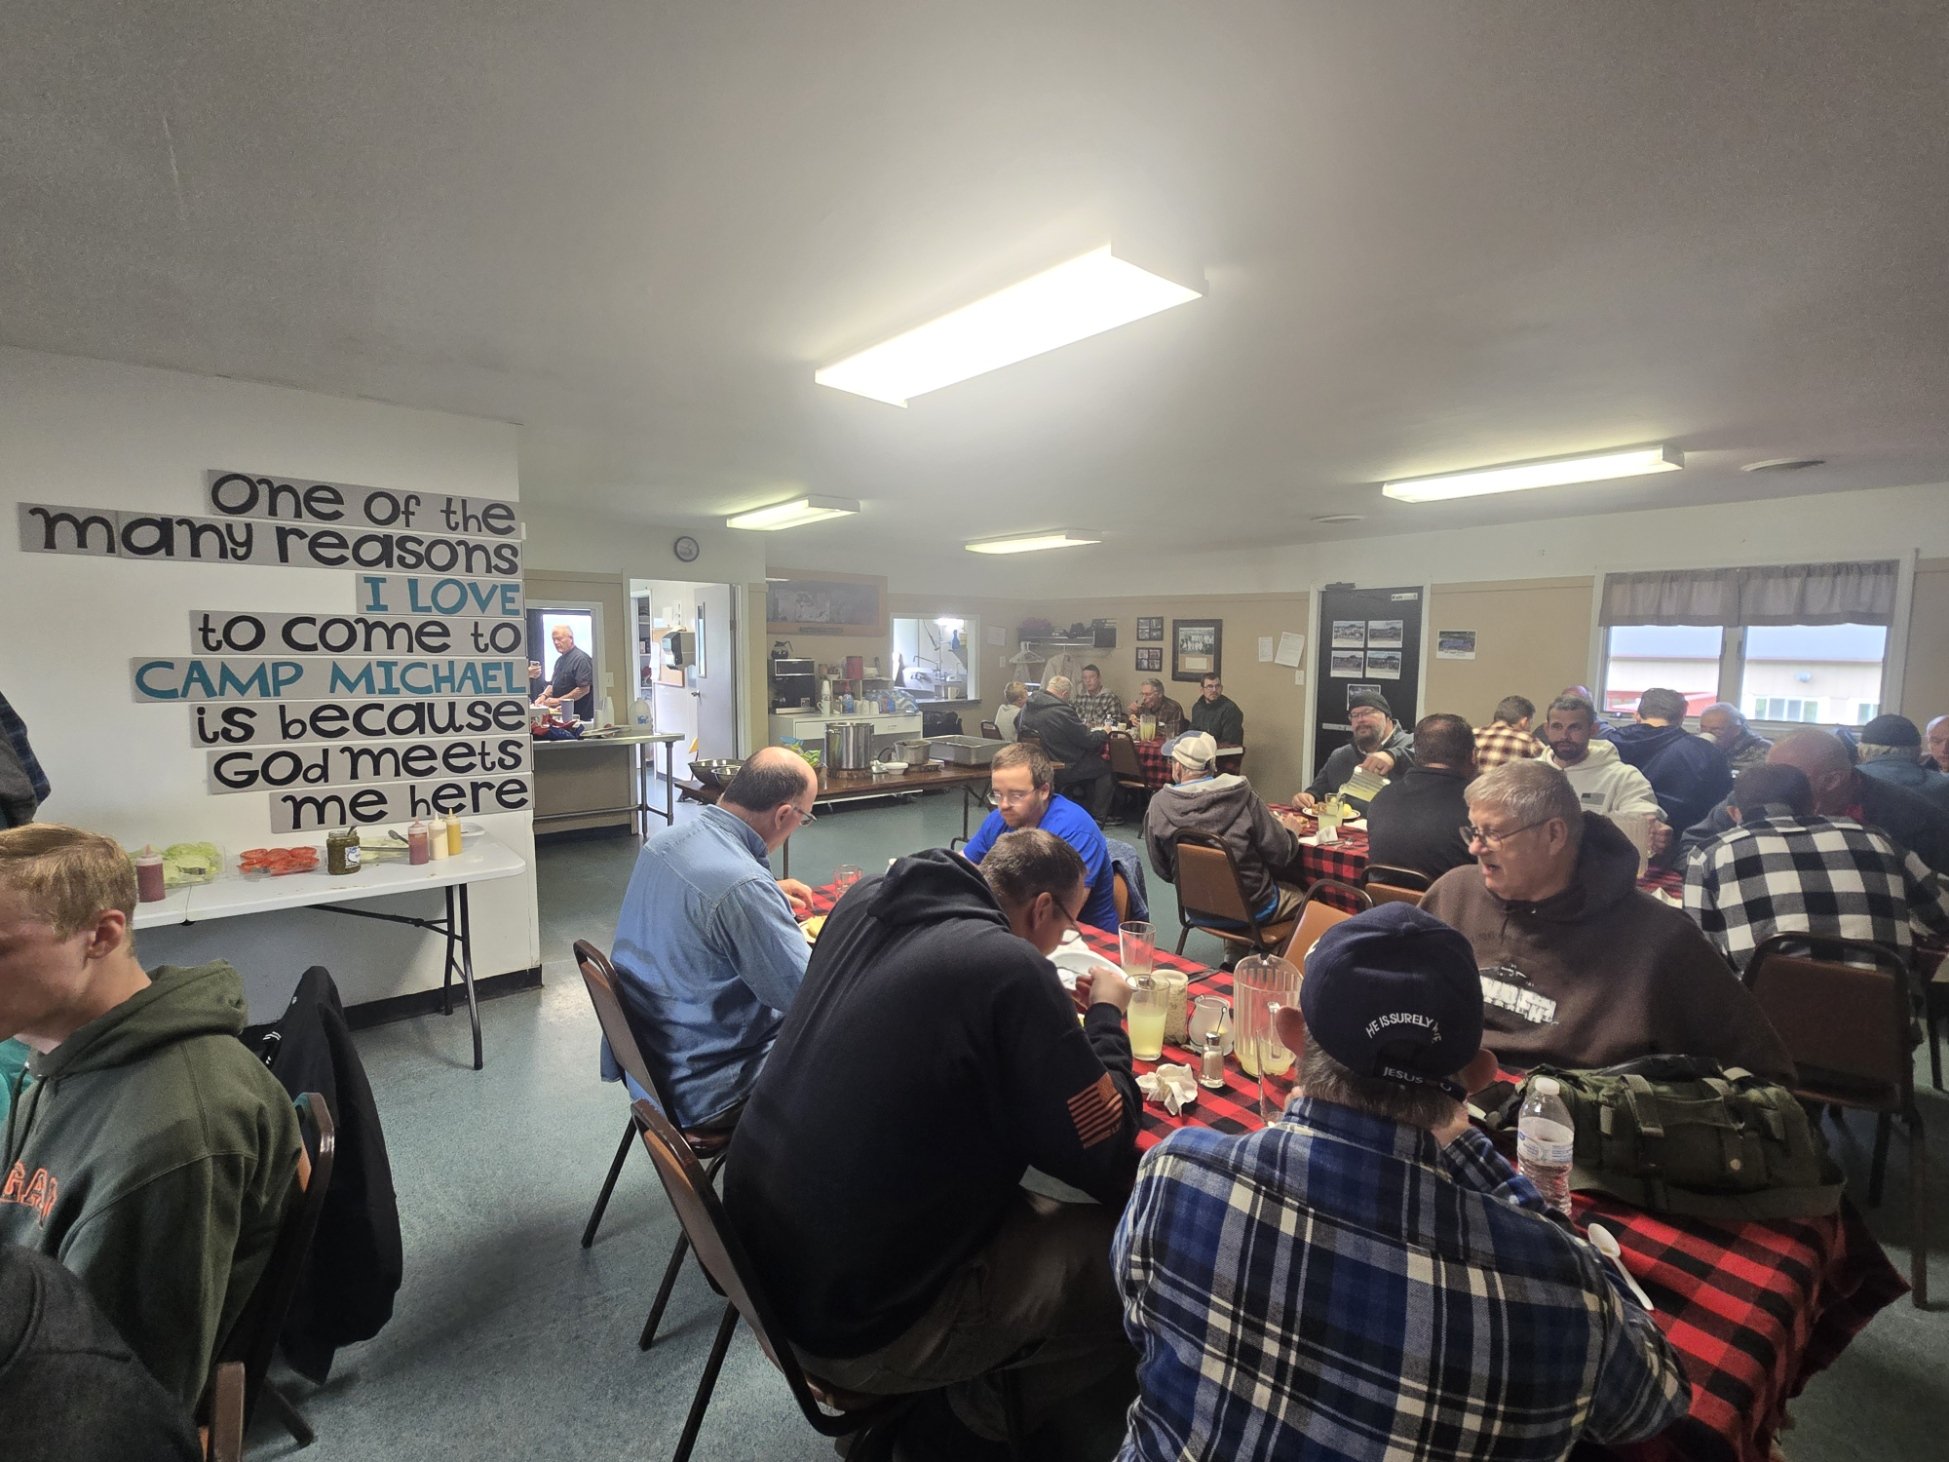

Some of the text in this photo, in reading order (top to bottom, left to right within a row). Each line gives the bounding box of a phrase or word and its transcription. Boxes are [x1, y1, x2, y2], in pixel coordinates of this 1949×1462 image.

[440, 497, 516, 536] the
[28, 507, 519, 575] many reasons
[363, 576, 521, 616] I LOVE
[198, 613, 522, 654] to come to
[134, 660, 527, 699] CAMP MICHAEL
[196, 700, 526, 744] is because
[213, 739, 524, 789] God meets
[281, 778, 529, 830] me here
[1365, 1012, 1434, 1039] HE IS SURELY
[1382, 1066, 1424, 1084] JESUS
